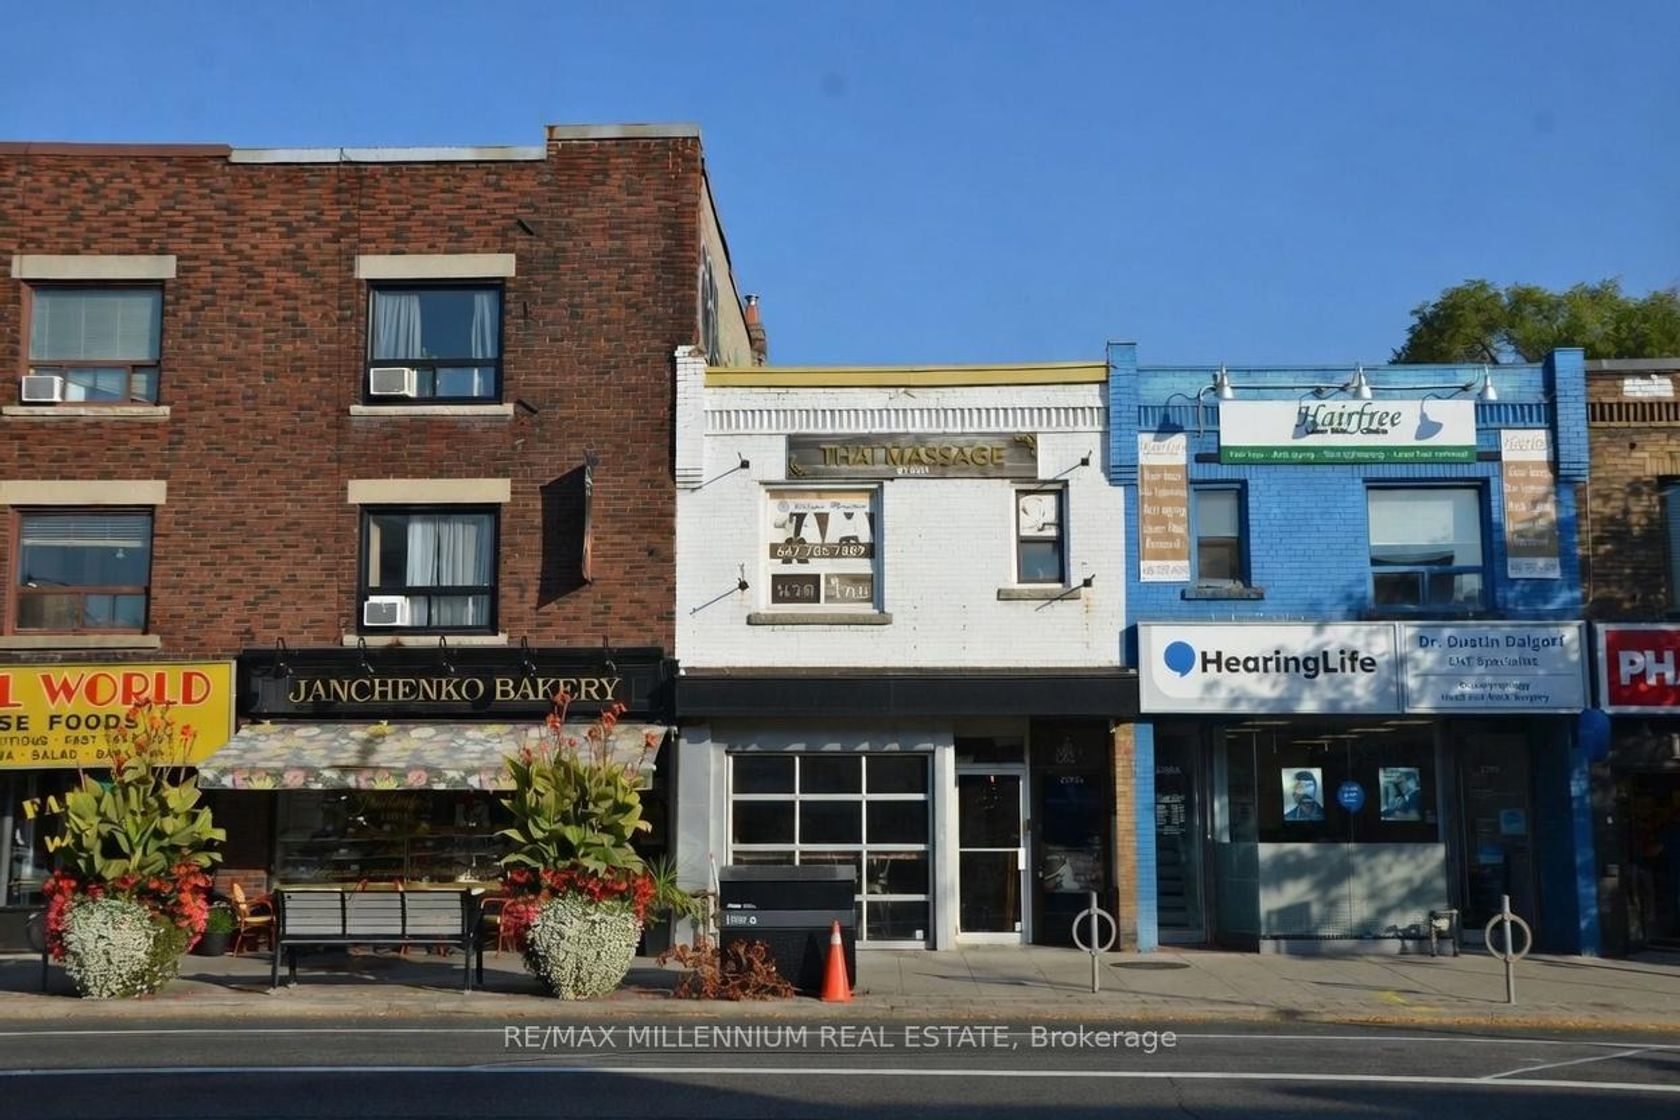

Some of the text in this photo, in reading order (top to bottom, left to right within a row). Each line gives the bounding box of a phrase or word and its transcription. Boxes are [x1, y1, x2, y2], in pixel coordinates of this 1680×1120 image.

[1298, 402, 1402, 434] Hairfree
[819, 442, 1008, 467] THAI MASSAGE
[1418, 635, 1442, 649] Dr.
[1447, 635, 1500, 649] Dustin
[1200, 649, 1377, 679] HearingLife
[1618, 650, 1680, 685] PH
[37, 669, 212, 709] WORLD
[288, 677, 623, 702] JANCHENKO BAKERY
